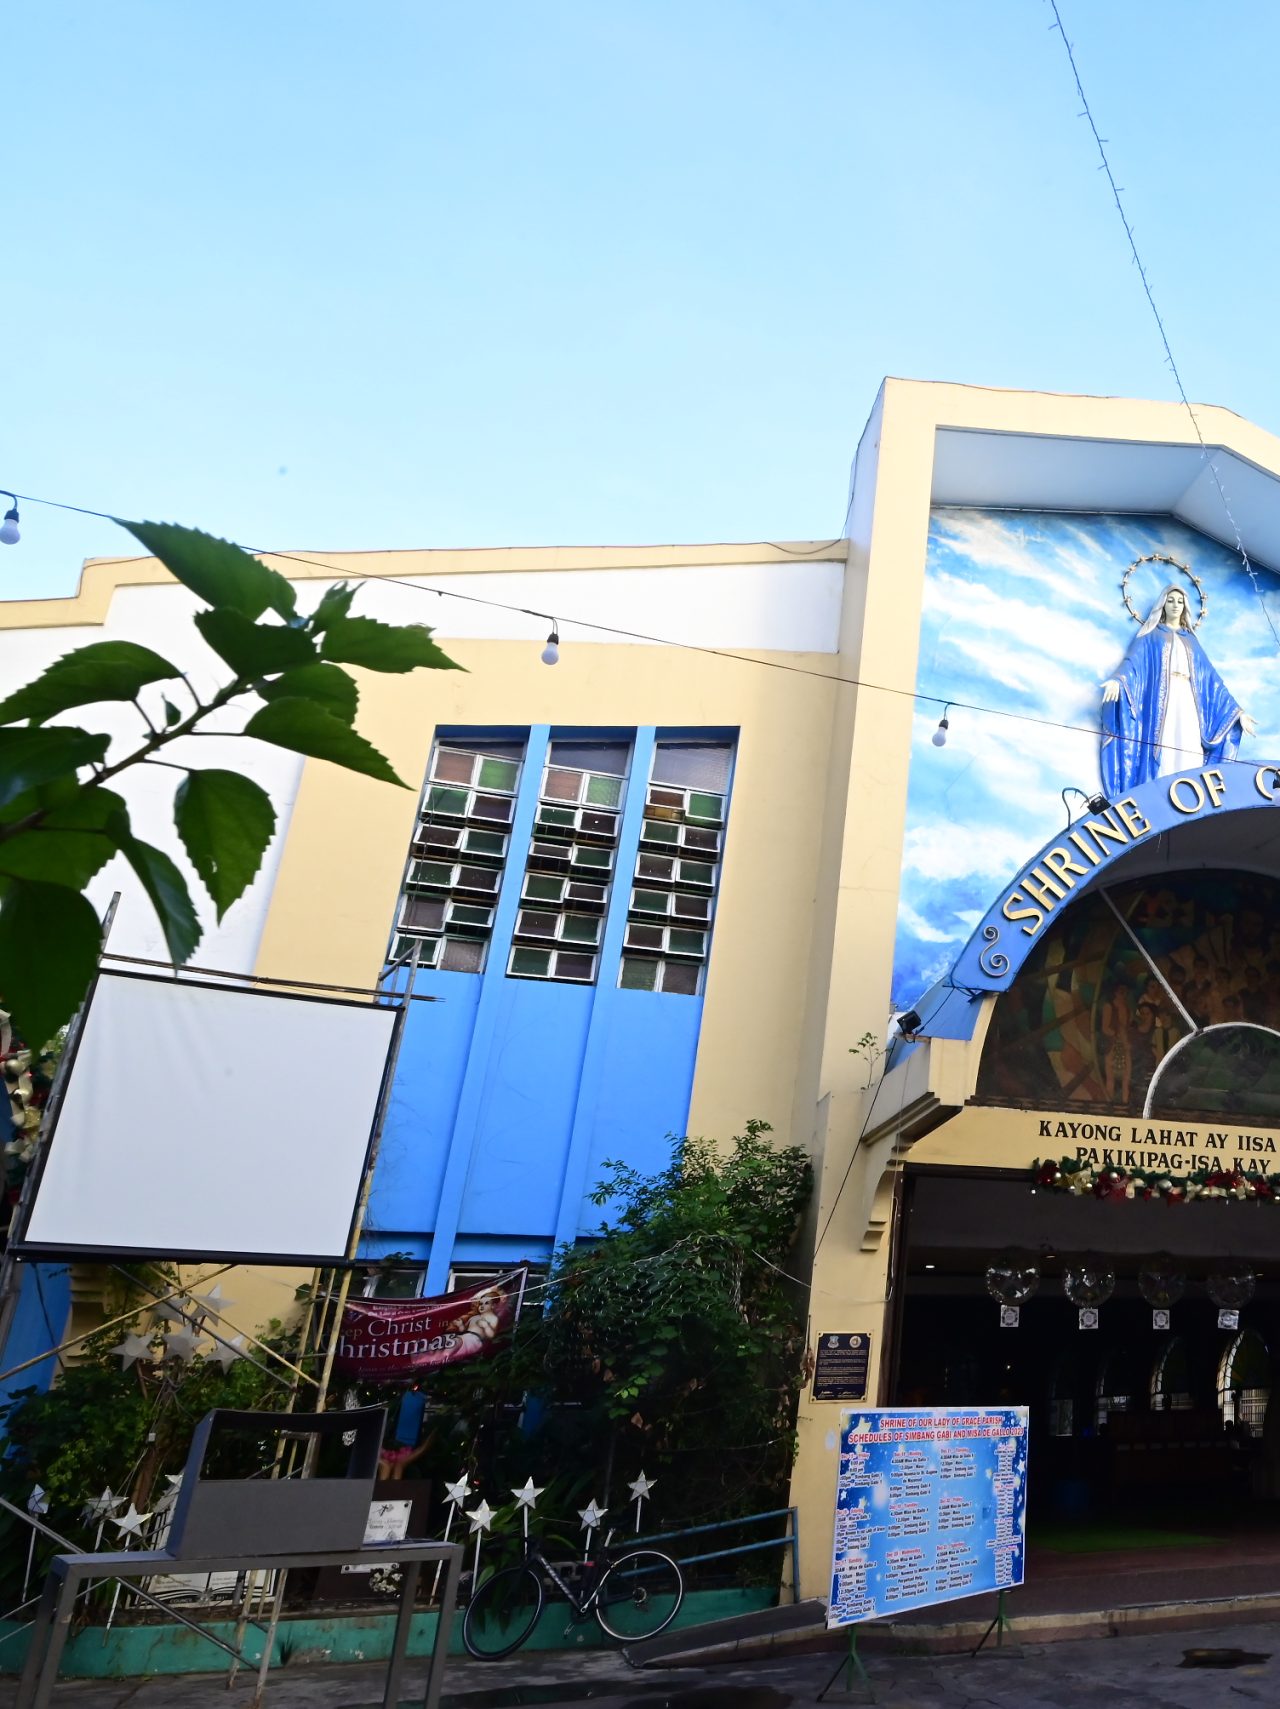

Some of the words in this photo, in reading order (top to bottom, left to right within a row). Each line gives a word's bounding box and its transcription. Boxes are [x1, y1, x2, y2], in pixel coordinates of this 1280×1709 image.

[1002, 797, 1151, 936] SHRINE
[1169, 769, 1226, 814] OF
[1039, 1120, 1122, 1142] KAYONG
[1131, 1127, 1198, 1148] LAHAT
[1205, 1133, 1229, 1149] AY
[1238, 1135, 1277, 1153] IISA
[1076, 1147, 1223, 1173] PAKIKIPAG-ISA
[1233, 1157, 1270, 1175] KAY
[368, 1316, 432, 1337] Christ
[880, 1419, 906, 1428] SHRINE
[908, 1419, 917, 1427] OF
[919, 1419, 932, 1427] OUR
[934, 1418, 950, 1426] LADY
[952, 1418, 960, 1426] OF
[962, 1417, 980, 1426] GRACE
[983, 1417, 1003, 1425] PARISH
[848, 1433, 892, 1443] SCHEDULES
[894, 1432, 903, 1441] OF
[905, 1431, 935, 1441] SIMBANG
[937, 1430, 952, 1439] GABI
[953, 1430, 966, 1438] AND
[967, 1429, 981, 1437] MISA
[983, 1429, 990, 1437] DE
[992, 1428, 1010, 1436] GALLO
